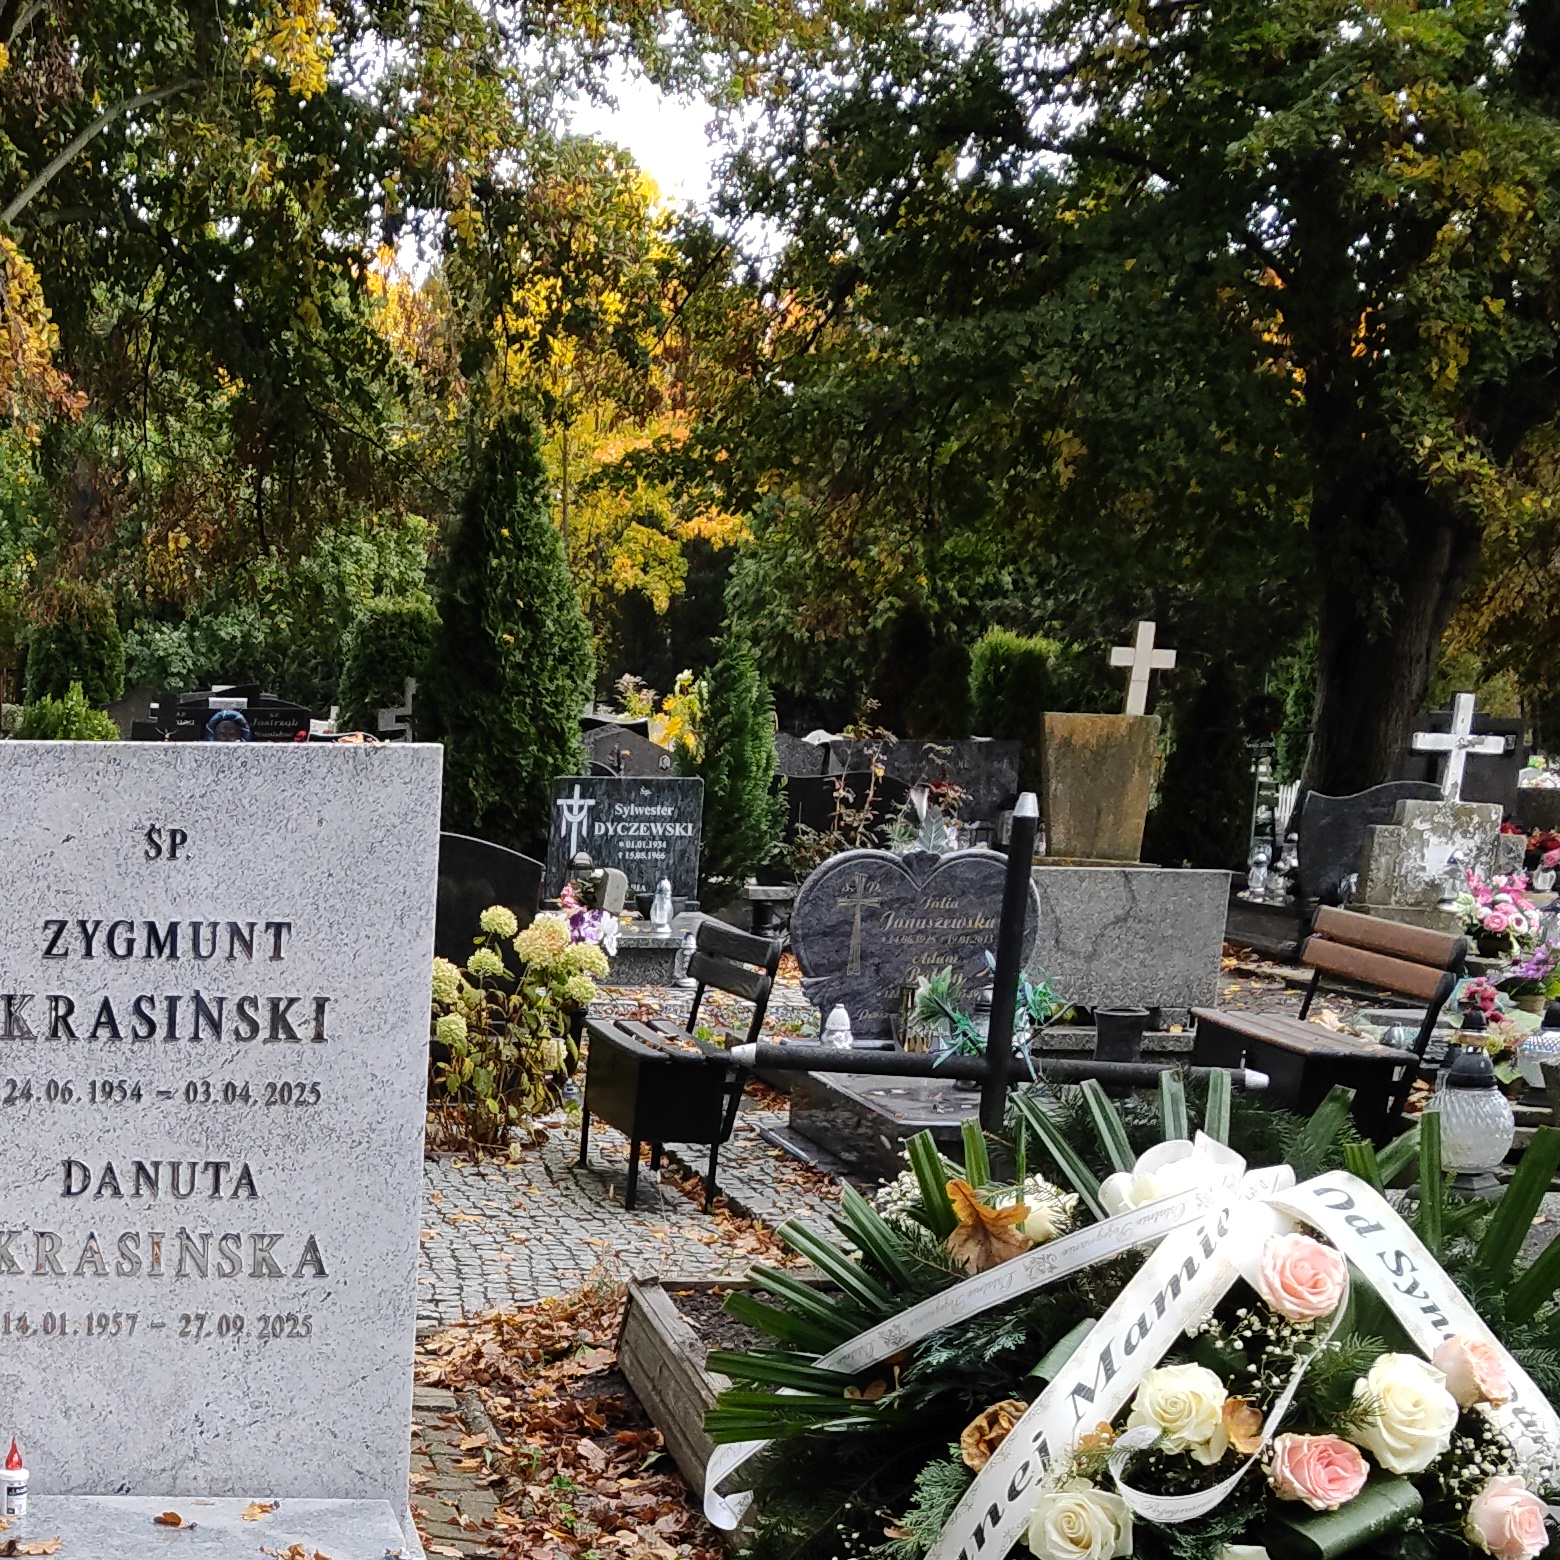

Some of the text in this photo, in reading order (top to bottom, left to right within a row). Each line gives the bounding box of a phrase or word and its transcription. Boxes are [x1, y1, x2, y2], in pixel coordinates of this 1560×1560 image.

[614, 803, 675, 818] Sylwester
[593, 821, 695, 837] DYCZEWSKI
[42, 919, 293, 961] ZYGMUNT
[0, 988, 331, 1043] KRASIŃSKI
[4, 1079, 143, 1106] 24.06.1954
[184, 1081, 322, 1107] 03.04.2025
[61, 1158, 260, 1200] DANUTA
[1375, 1249, 1456, 1340] Syn
[1, 1312, 139, 1337] 14.01.1957
[177, 1313, 314, 1339] 27.09.2025
